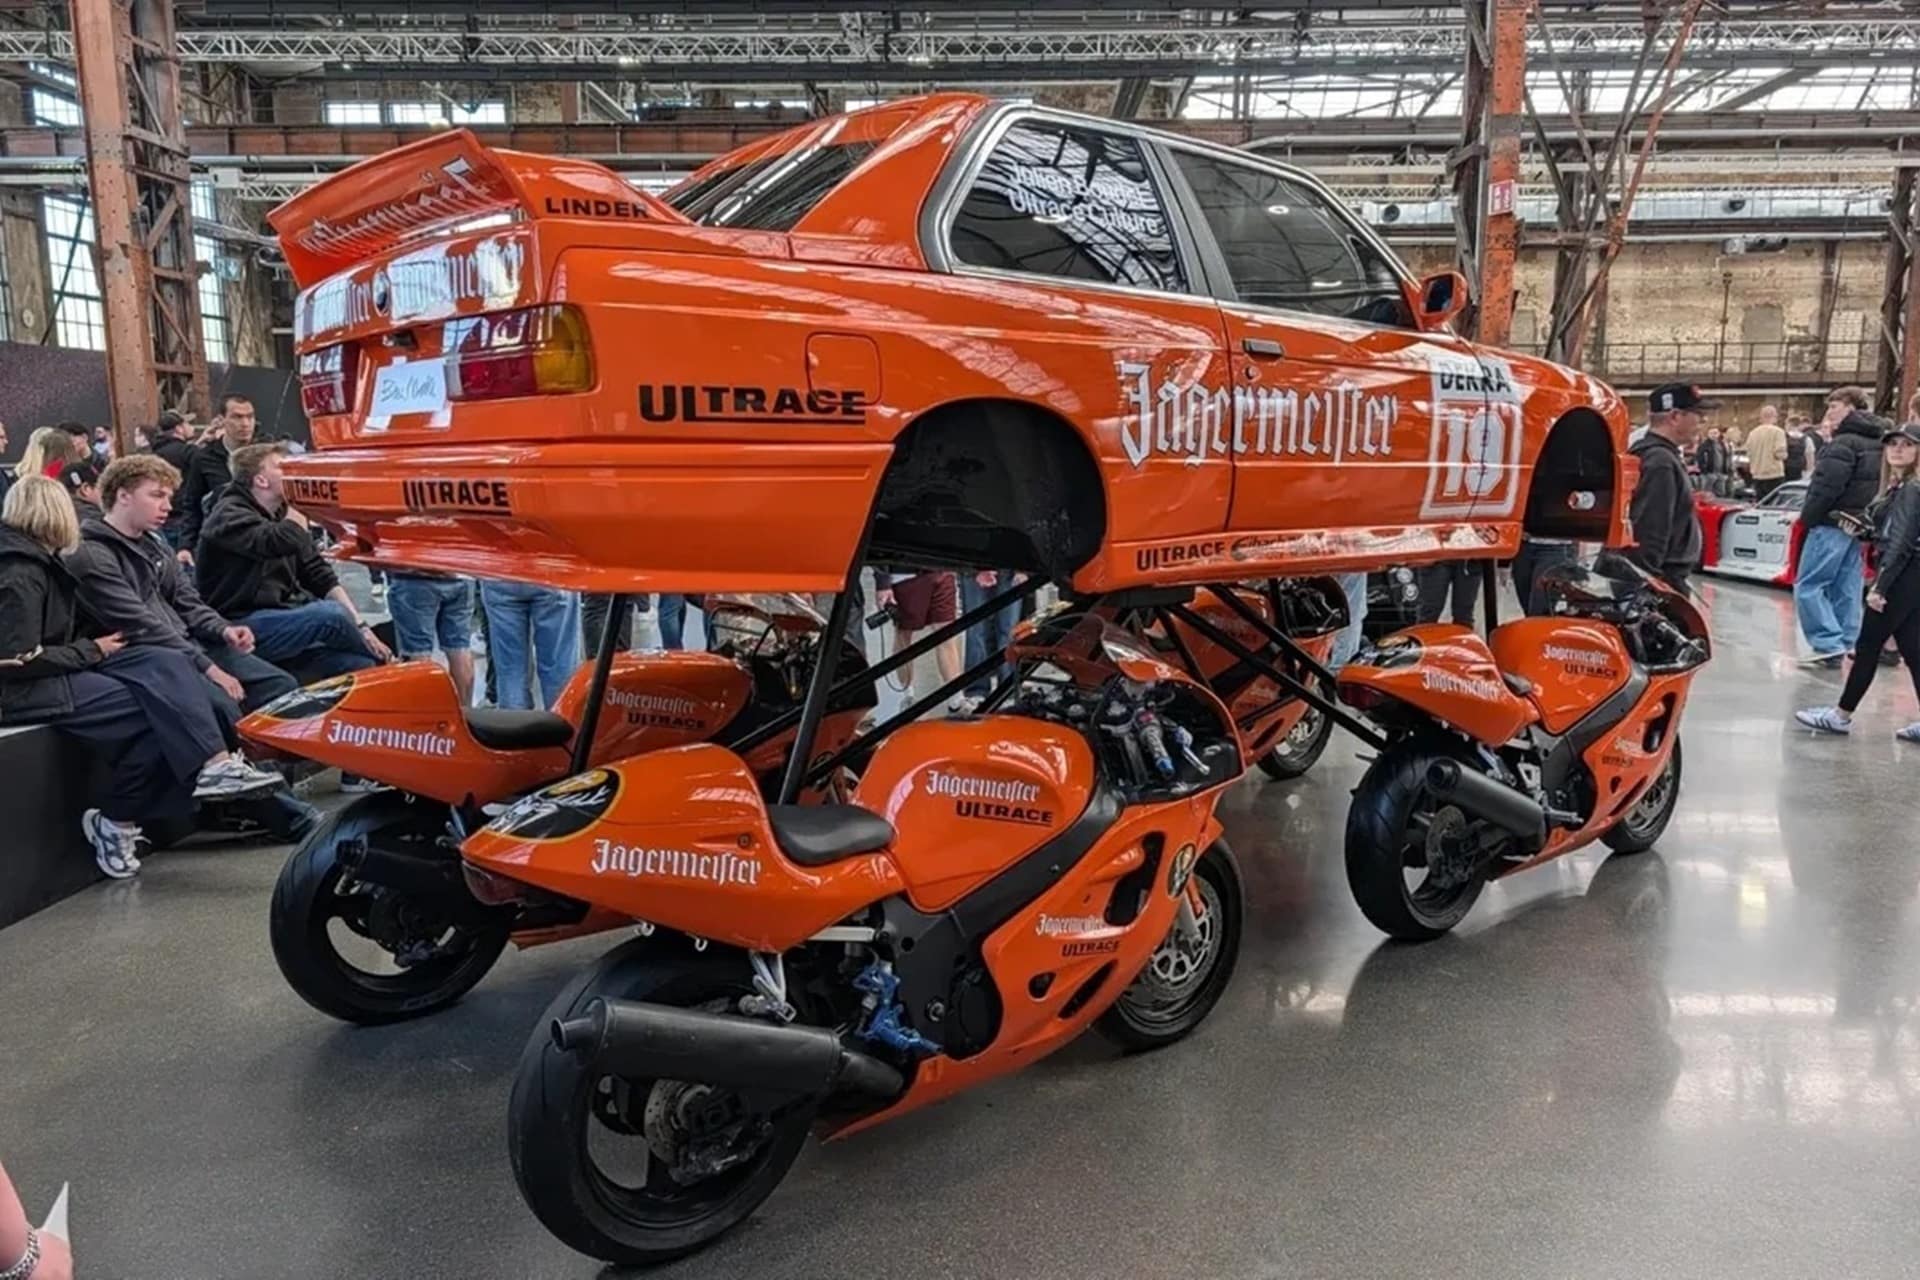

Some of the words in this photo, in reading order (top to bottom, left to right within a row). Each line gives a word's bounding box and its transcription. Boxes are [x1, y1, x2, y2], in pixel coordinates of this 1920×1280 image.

[545, 197, 649, 218] LINDER
[1440, 362, 1511, 393] DEKRA
[639, 384, 866, 424] ULTRACE
[402, 480, 513, 516] ULTRACE
[1136, 540, 1226, 571] ULTRACE
[955, 800, 1054, 827] ULTRACE
[1061, 940, 1120, 957] ULTRACE
